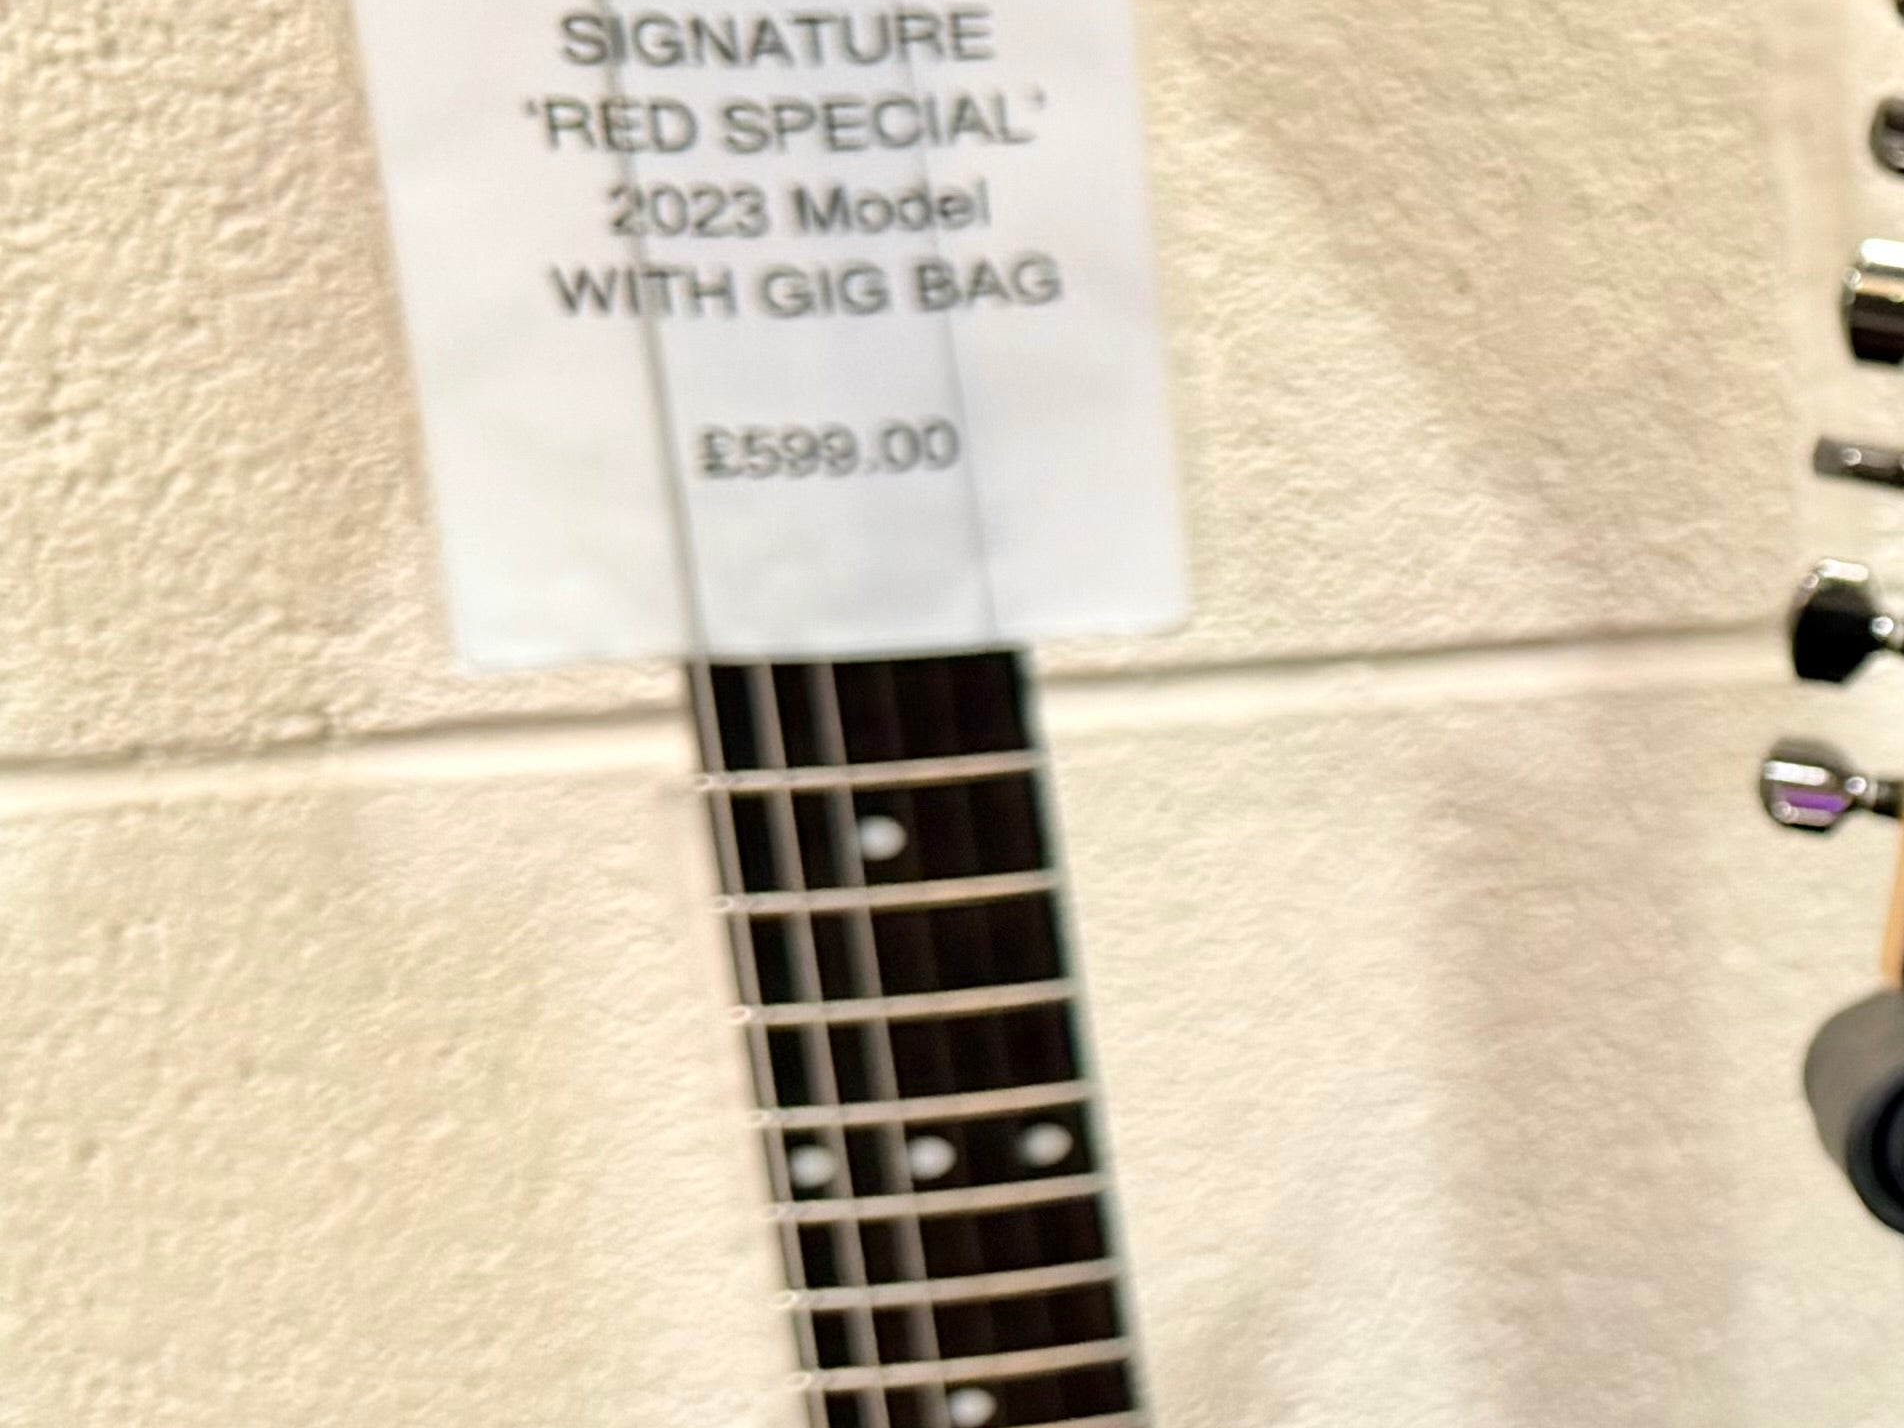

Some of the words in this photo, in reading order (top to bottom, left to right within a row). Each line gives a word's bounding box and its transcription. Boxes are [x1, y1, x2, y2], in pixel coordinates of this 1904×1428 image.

[559, 8, 995, 69] SIGNATURE
[607, 184, 769, 239] 2023
[796, 178, 992, 234] Model
[549, 264, 738, 319] WITH
[760, 263, 891, 319] GIG
[915, 251, 1063, 313] BAG
[699, 419, 961, 480] £599.00
